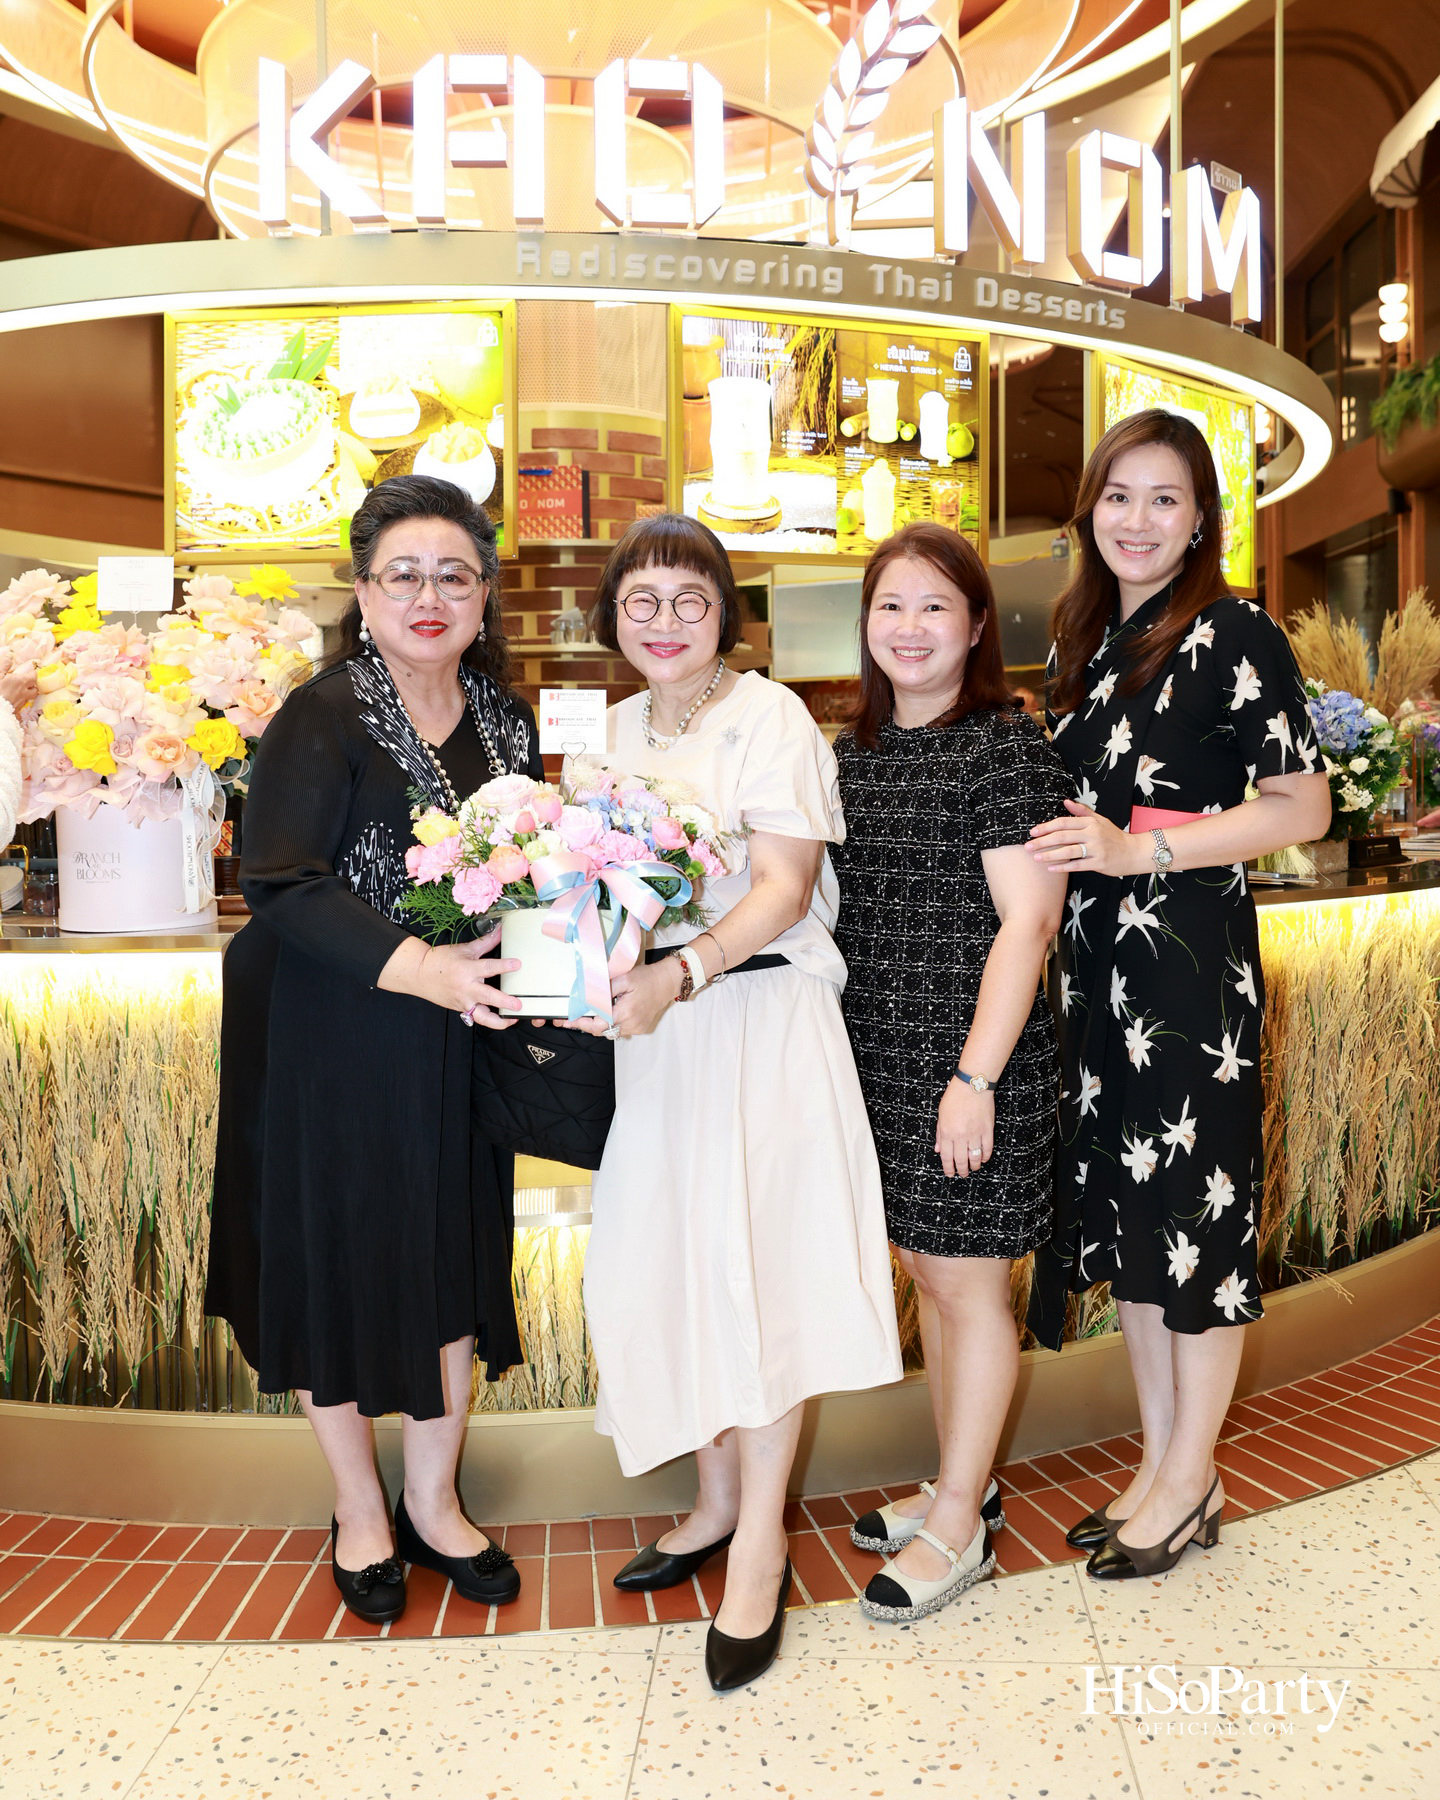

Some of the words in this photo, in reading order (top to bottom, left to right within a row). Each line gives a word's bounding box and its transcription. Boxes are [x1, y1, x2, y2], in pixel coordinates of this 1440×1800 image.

[259, 53, 724, 232] KAO
[933, 97, 1262, 325] NOM
[516, 240, 844, 295] Rediscovering
[868, 263, 953, 303] Thai
[974, 276, 1127, 330] Desserts
[880, 363, 908, 373] HERBAL
[910, 365, 937, 375] DRINKS
[536, 498, 566, 509] NOM
[72, 850, 121, 868] BRANCH
[76, 868, 122, 880] BLOOMS
